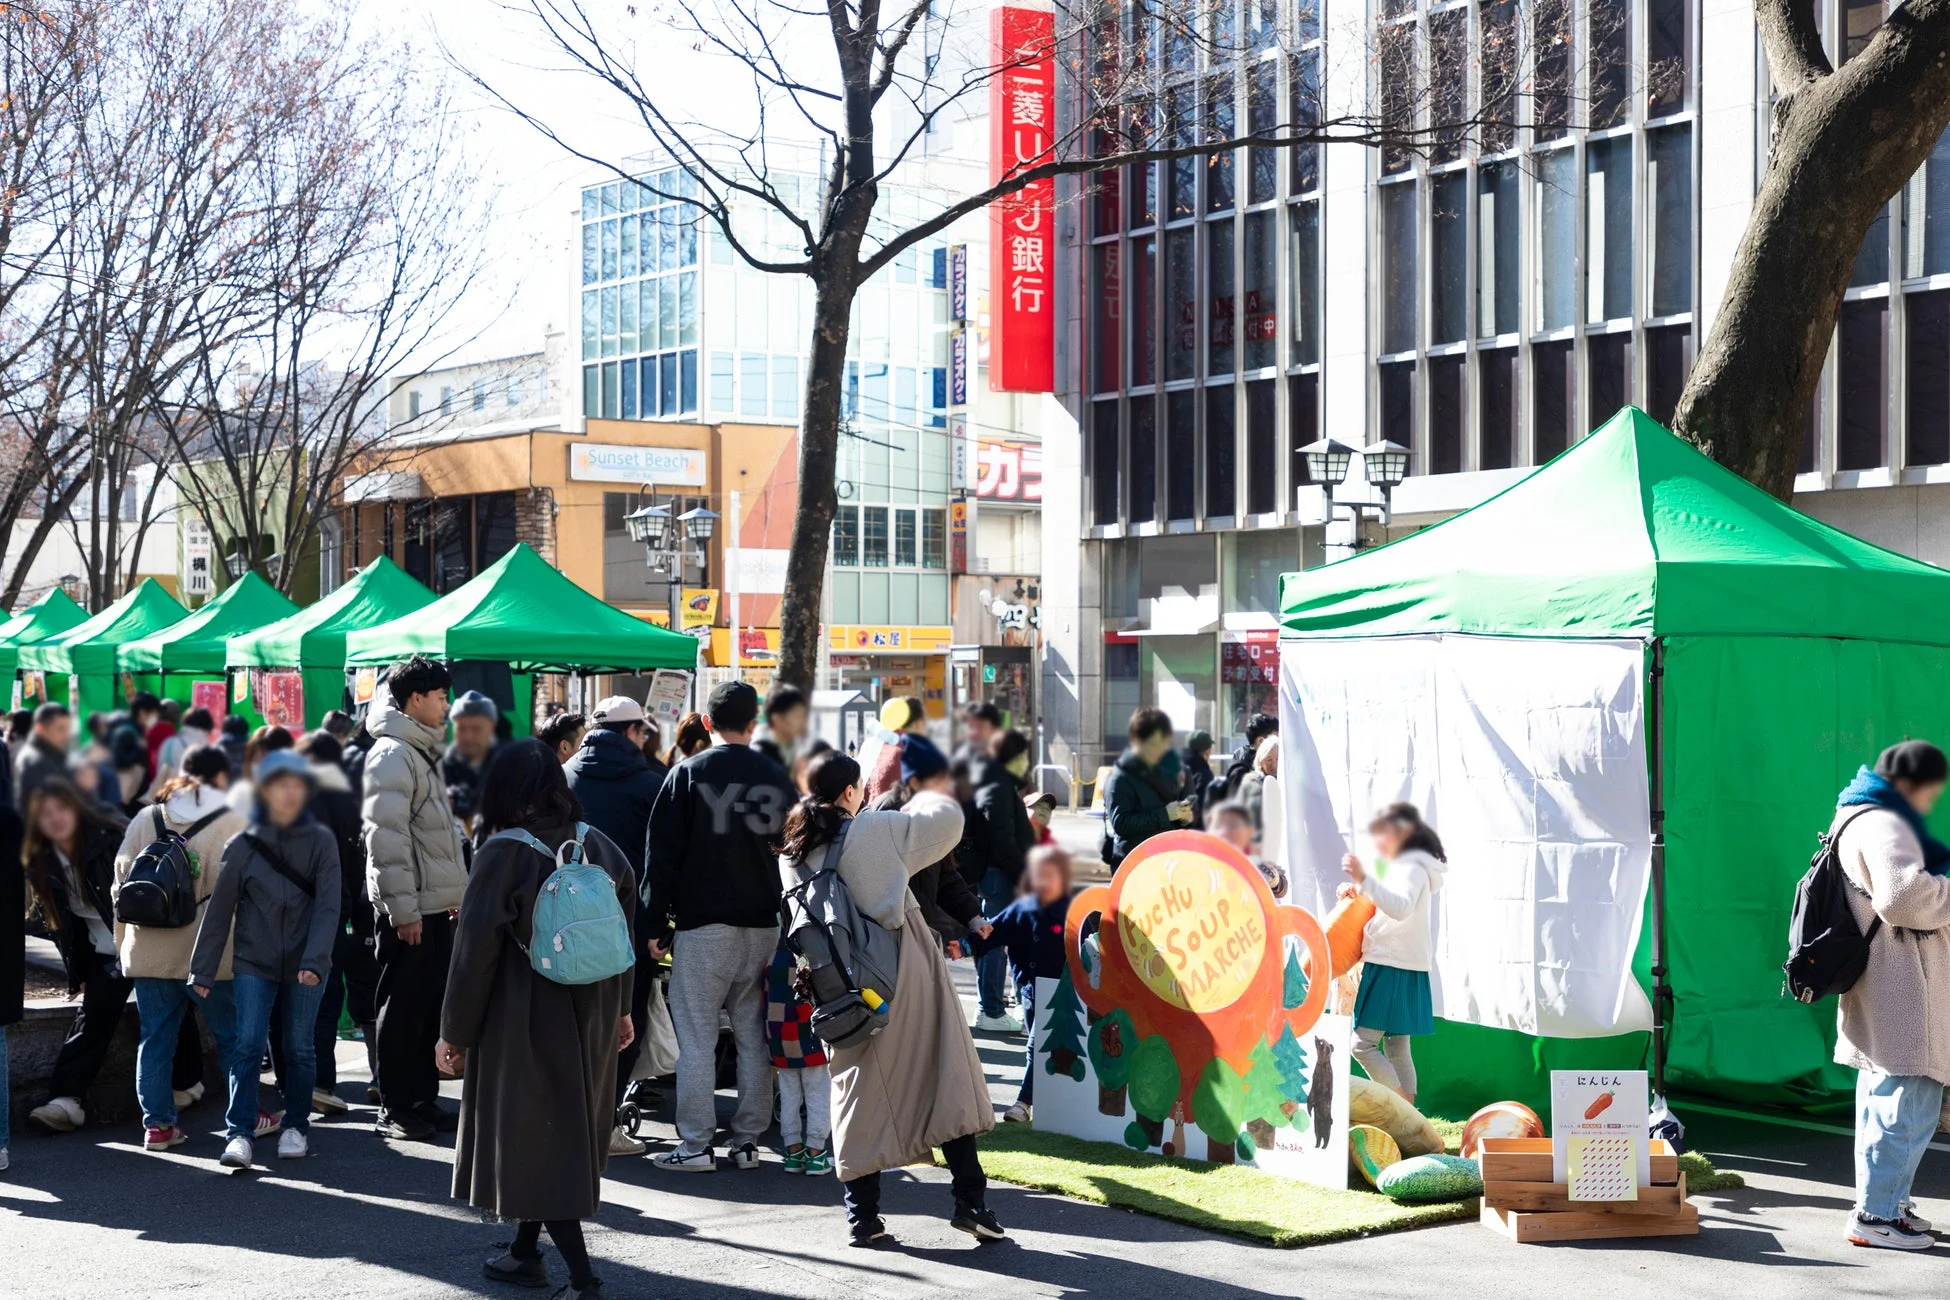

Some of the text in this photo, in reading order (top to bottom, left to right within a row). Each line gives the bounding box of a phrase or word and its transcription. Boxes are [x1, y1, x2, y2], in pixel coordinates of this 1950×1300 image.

[588, 449, 689, 469] Sunset Beach
[192, 557, 207, 589] 梶川
[873, 631, 900, 646] 松屋
[697, 782, 784, 835] Y-3
[1577, 1076, 1622, 1086] にんじん
